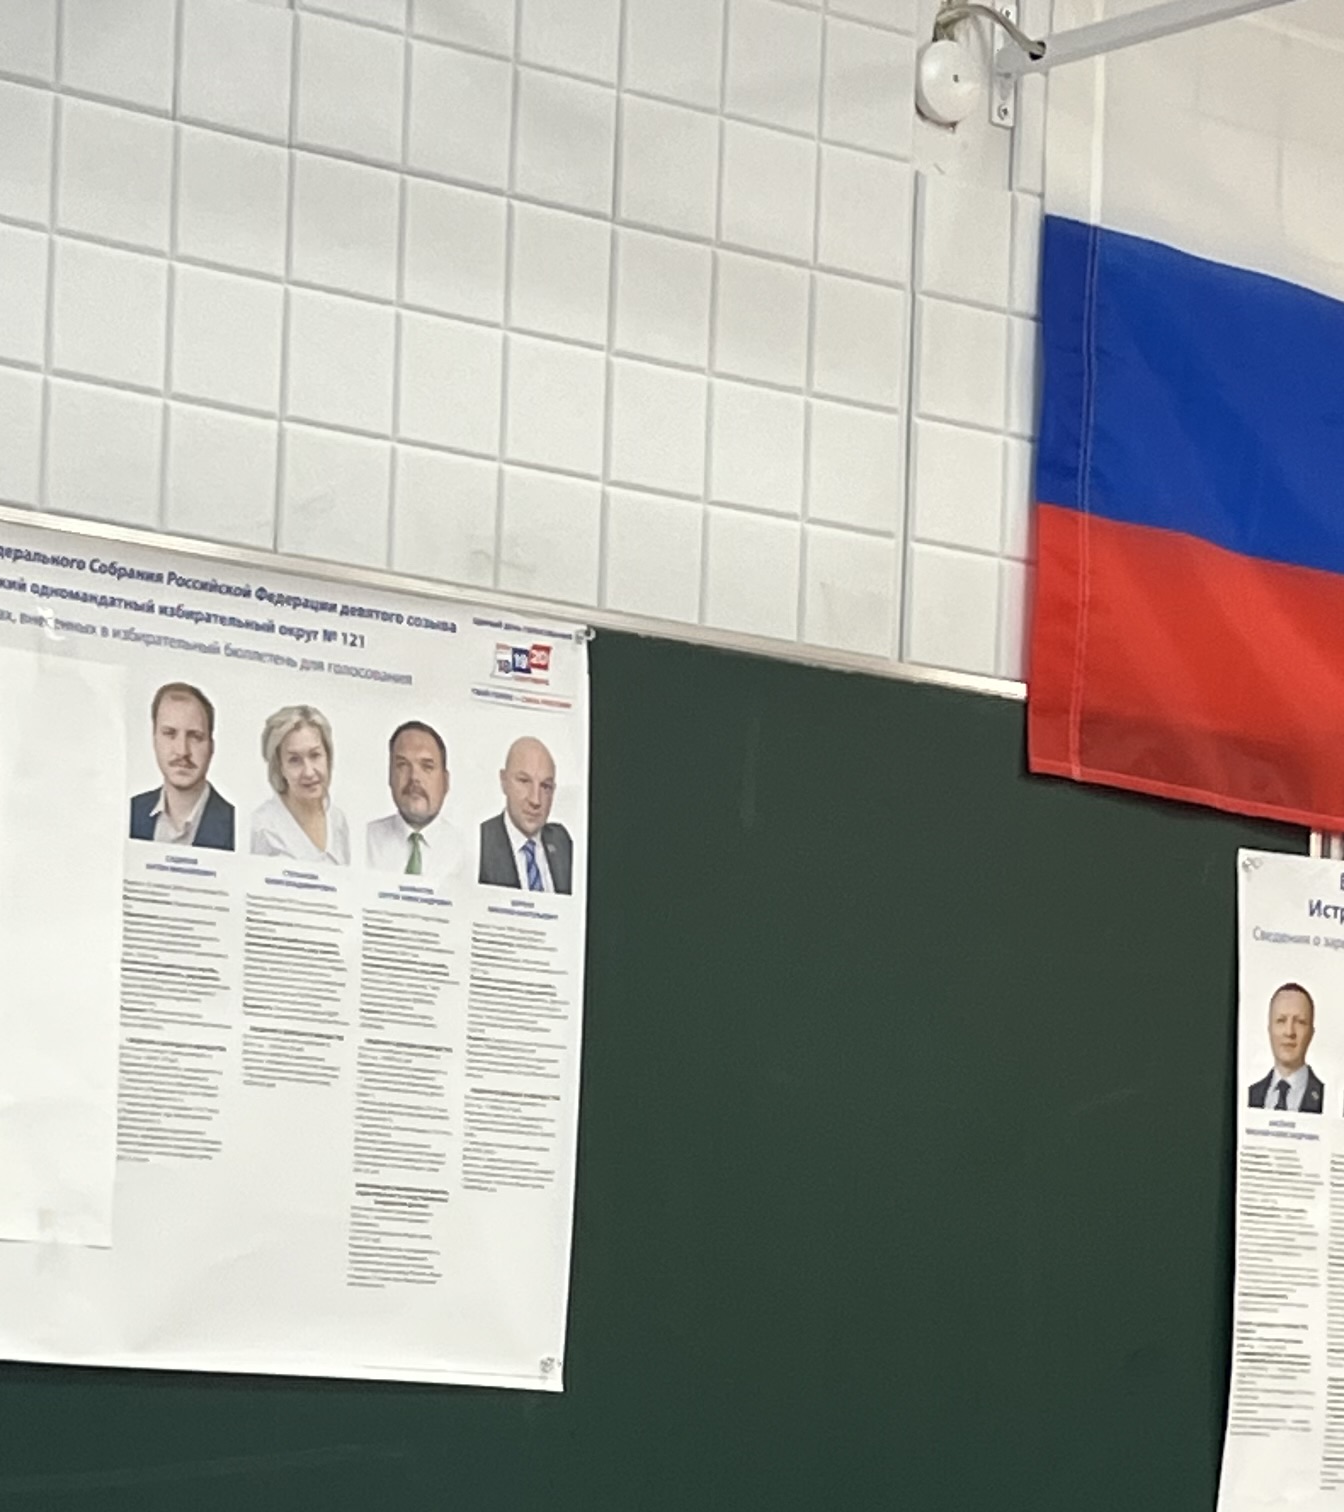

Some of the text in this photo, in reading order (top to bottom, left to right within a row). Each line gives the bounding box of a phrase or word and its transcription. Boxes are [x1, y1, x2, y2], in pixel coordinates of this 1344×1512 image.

[20, 613, 96, 635] внеенных
[30, 579, 156, 615] одномандатный
[158, 600, 277, 637] избирательный
[279, 622, 319, 645] округ
[322, 628, 339, 646] №
[341, 631, 366, 649] 121
[88, 557, 165, 585] Собрания
[167, 570, 252, 600] Российской
[255, 586, 338, 612] Федерации
[340, 601, 404, 626] девятого
[406, 614, 457, 634] созыва
